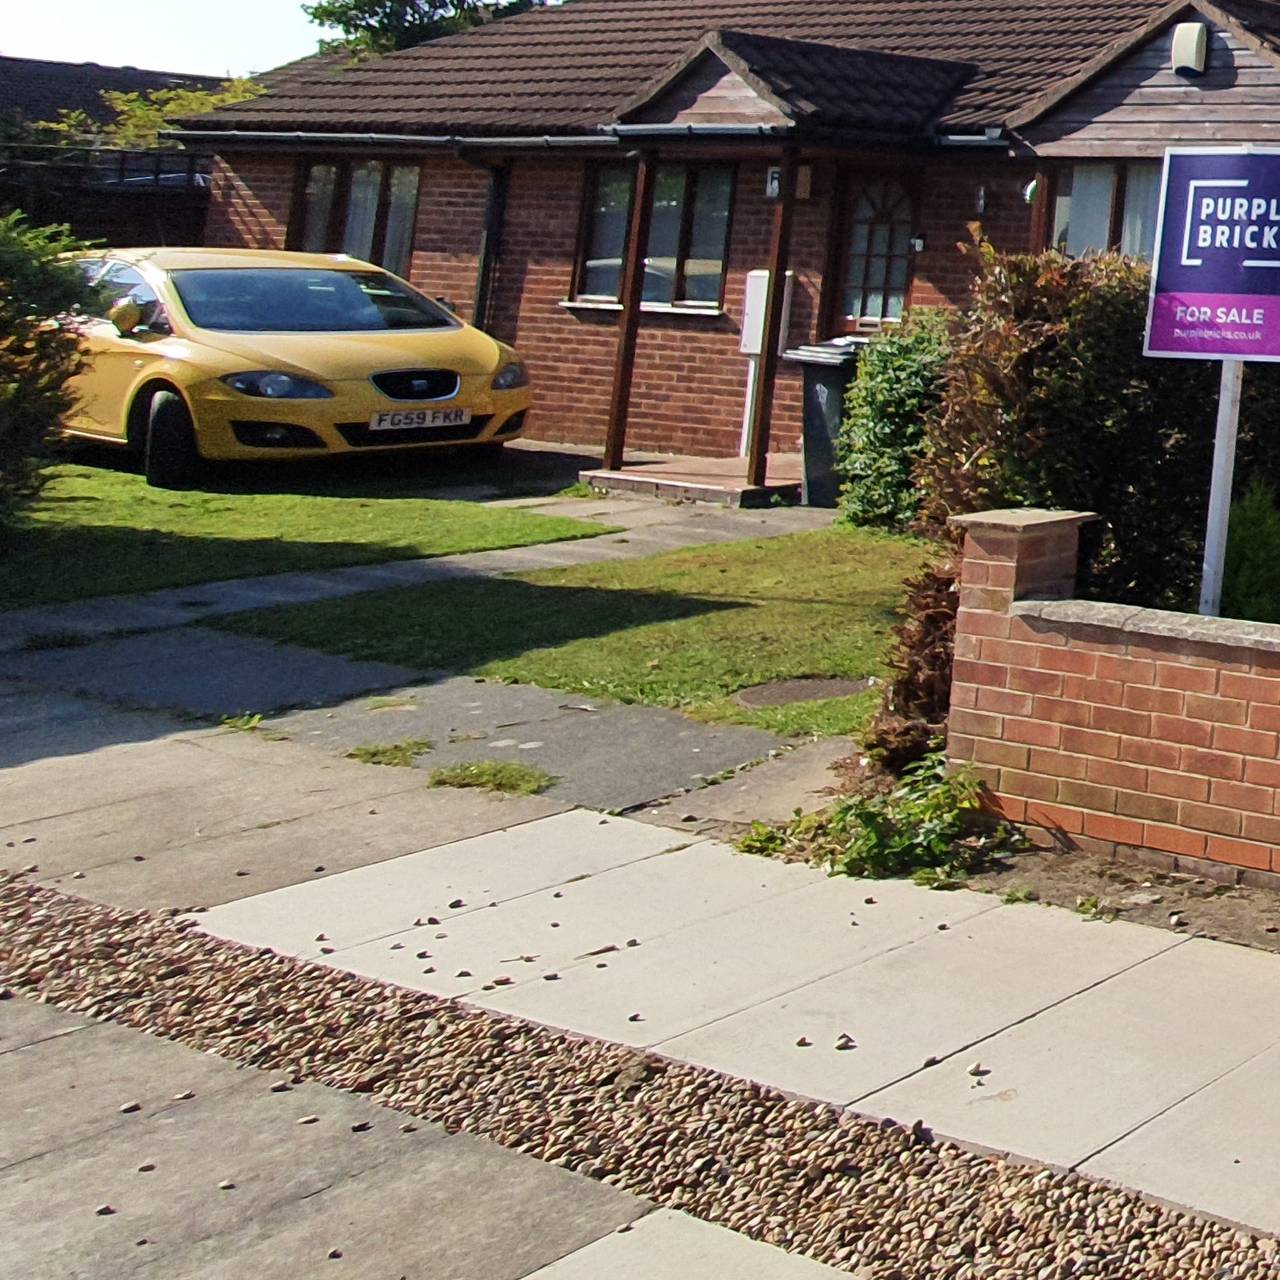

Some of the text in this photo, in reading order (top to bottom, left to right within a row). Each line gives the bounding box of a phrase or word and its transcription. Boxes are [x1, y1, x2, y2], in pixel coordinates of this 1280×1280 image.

[1175, 306, 1265, 325] FOR SALE
[378, 412, 426, 427] FG59
